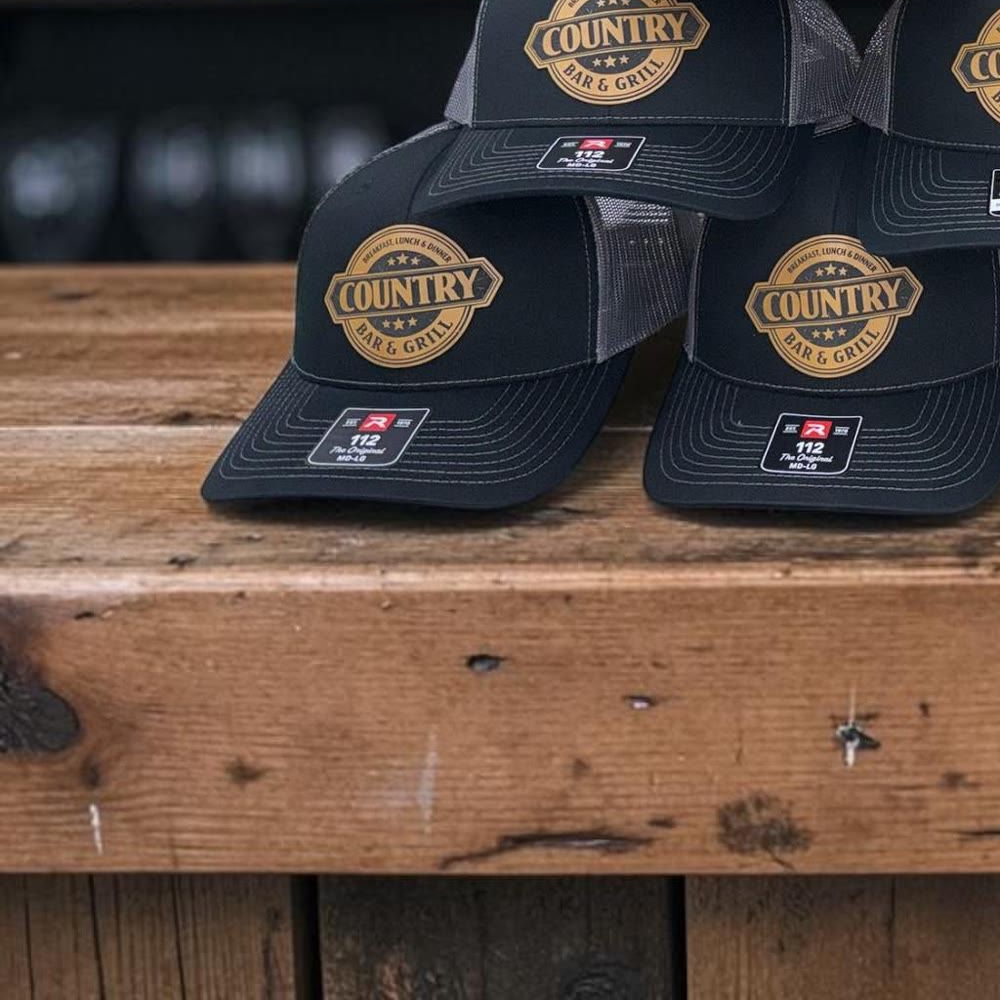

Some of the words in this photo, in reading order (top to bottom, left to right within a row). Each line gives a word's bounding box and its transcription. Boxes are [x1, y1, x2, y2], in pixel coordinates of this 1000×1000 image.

[542, 12, 688, 56] COUNTRY
[563, 63, 593, 90] BAR
[598, 78, 608, 91] &
[615, 58, 664, 90] GRILL
[395, 237, 420, 246] LUNCH
[427, 243, 452, 263] DINNER
[822, 248, 846, 256] LUNCH
[853, 253, 877, 272] DINNER
[339, 268, 479, 312] COUNTRY
[763, 278, 901, 321] COUNTRY
[355, 322, 382, 351] BAR
[387, 342, 396, 355] &
[403, 320, 453, 353] GRILL
[784, 332, 812, 361] BAR
[817, 352, 826, 364] &
[833, 330, 880, 363] GRILL
[329, 446, 346, 454] The
[347, 447, 386, 455] Original
[351, 434, 381, 446] 112
[796, 442, 824, 454] 112
[780, 453, 795, 461] The
[797, 454, 834, 463] Original
